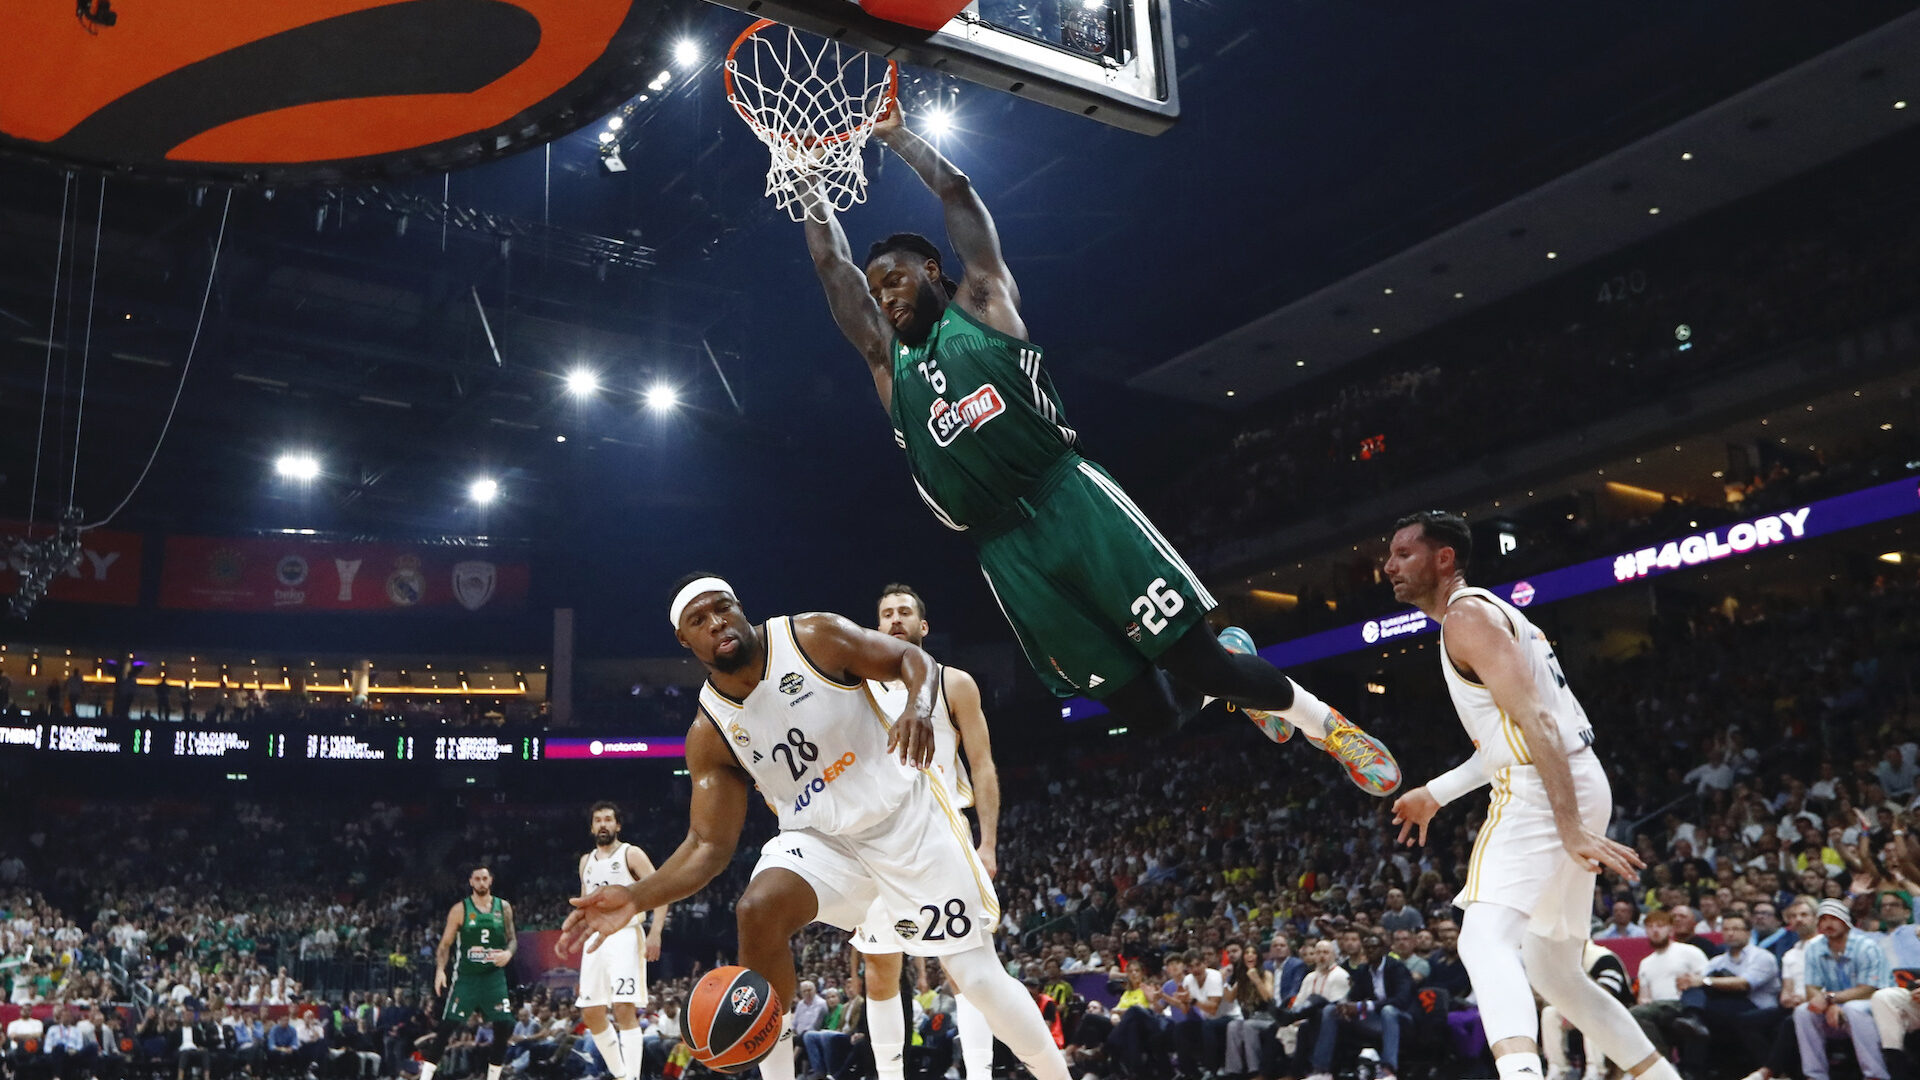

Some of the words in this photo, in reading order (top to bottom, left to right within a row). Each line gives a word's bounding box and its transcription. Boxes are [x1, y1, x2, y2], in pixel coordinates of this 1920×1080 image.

[1613, 507, 1811, 582] #F4GLORY
[1131, 578, 1184, 636] 26
[604, 742, 648, 752] motorola
[772, 728, 818, 782] 28
[920, 899, 971, 941] 28
[481, 929, 490, 943] 2
[616, 978, 636, 995] 23
[502, 998, 511, 1013] 2
